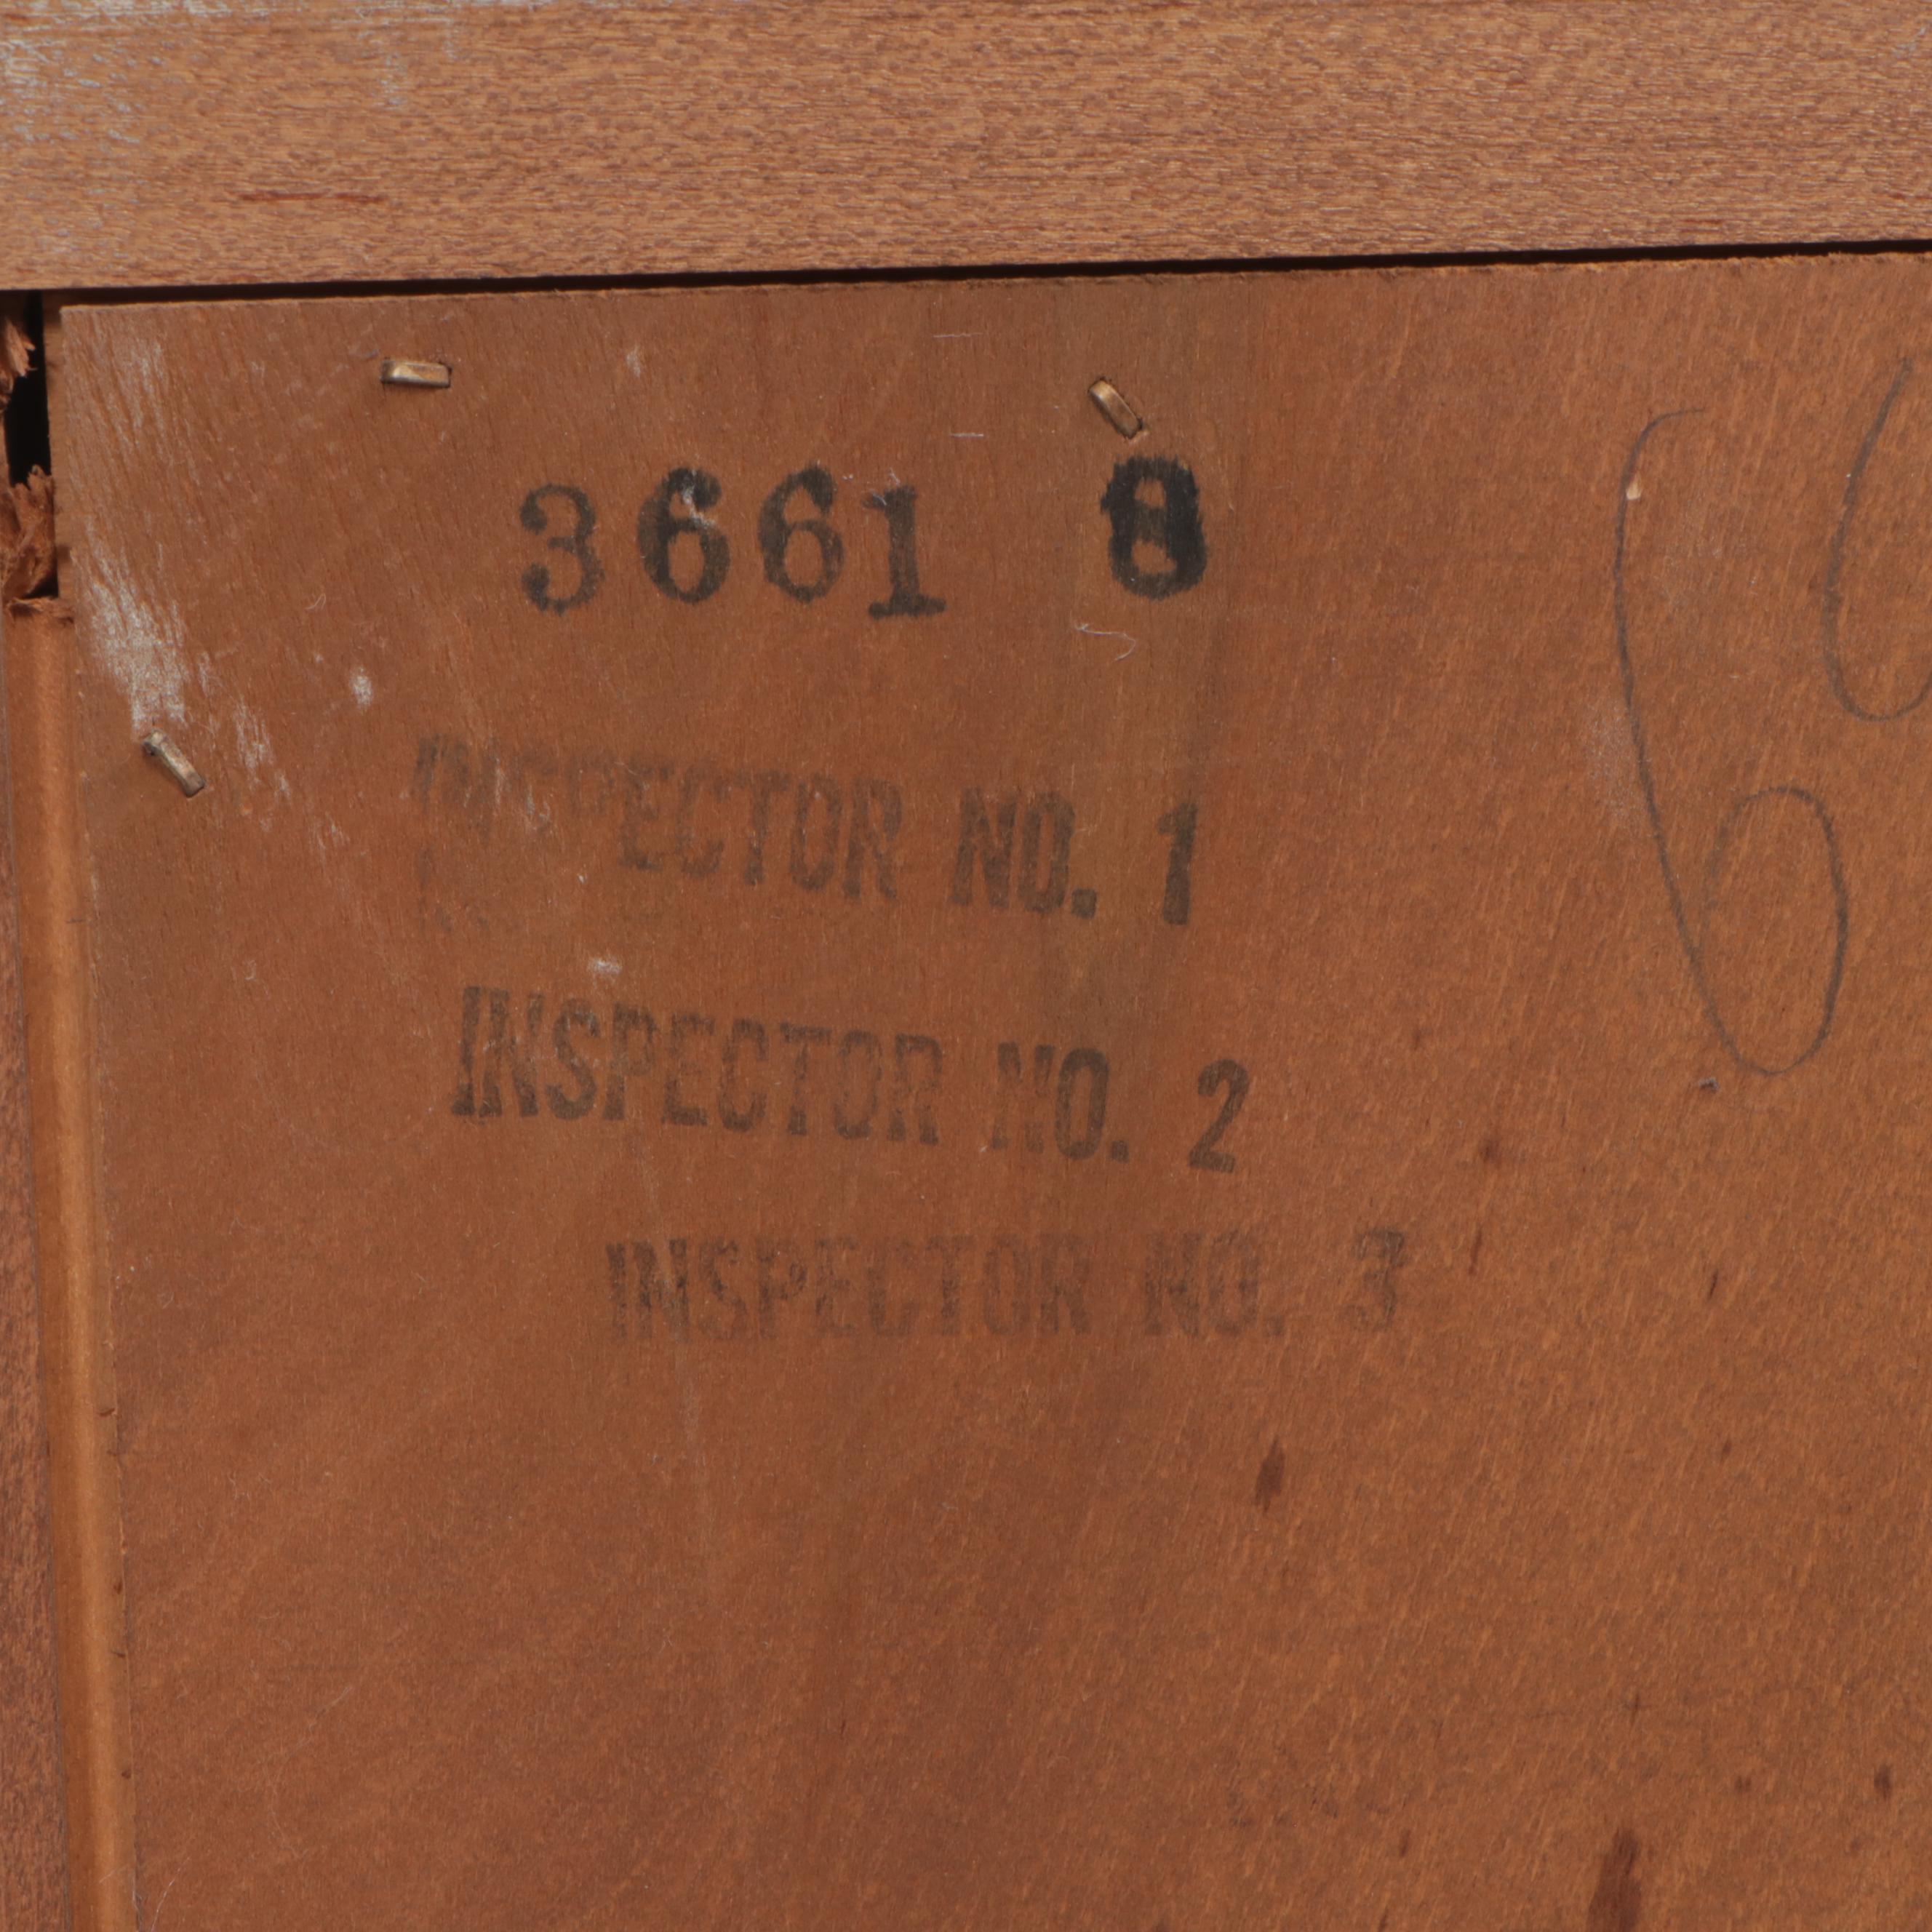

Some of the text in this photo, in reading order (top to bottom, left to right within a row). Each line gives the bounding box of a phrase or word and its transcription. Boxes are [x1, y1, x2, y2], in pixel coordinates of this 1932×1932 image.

[519, 452, 1208, 619] 3661 8
[951, 787, 1098, 920] NO.
[1157, 800, 1199, 927] 1
[450, 986, 1250, 1174] INSPECTOR NO. 2
[605, 1225, 1411, 1343] INSPECTOR NO. 3
